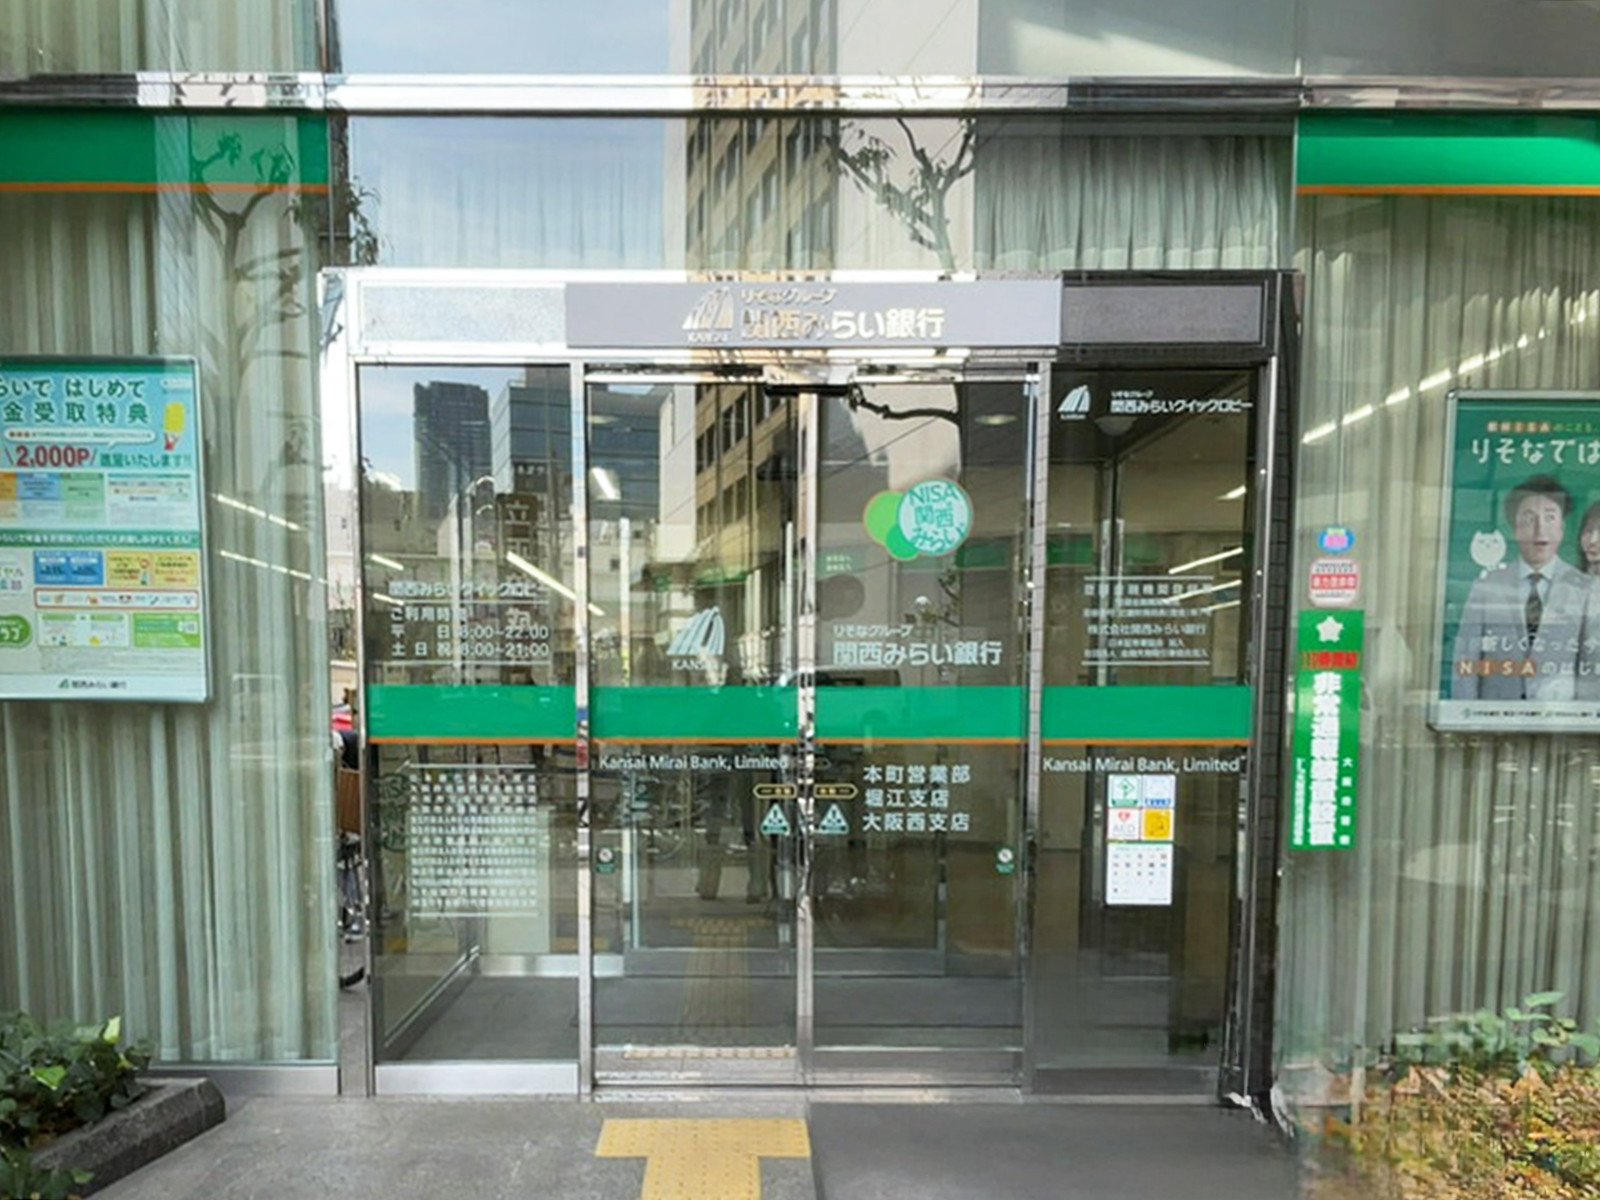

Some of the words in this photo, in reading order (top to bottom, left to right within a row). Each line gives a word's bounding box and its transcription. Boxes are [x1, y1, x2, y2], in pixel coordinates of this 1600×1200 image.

[16, 445, 90, 467] 2,000P
[909, 483, 958, 506] NISA
[833, 641, 1003, 665] 関西みらい銀行
[600, 755, 644, 770] Kansai
[650, 755, 687, 770] Mirai
[691, 755, 731, 771] Bank,
[1043, 757, 1091, 772] Kansai
[1095, 757, 1134, 772] Mirai
[1137, 757, 1180, 774] Bank,
[1183, 757, 1240, 772] Limited
[863, 765, 971, 785] 本町営業部
[862, 813, 970, 832] 大阪西支店
